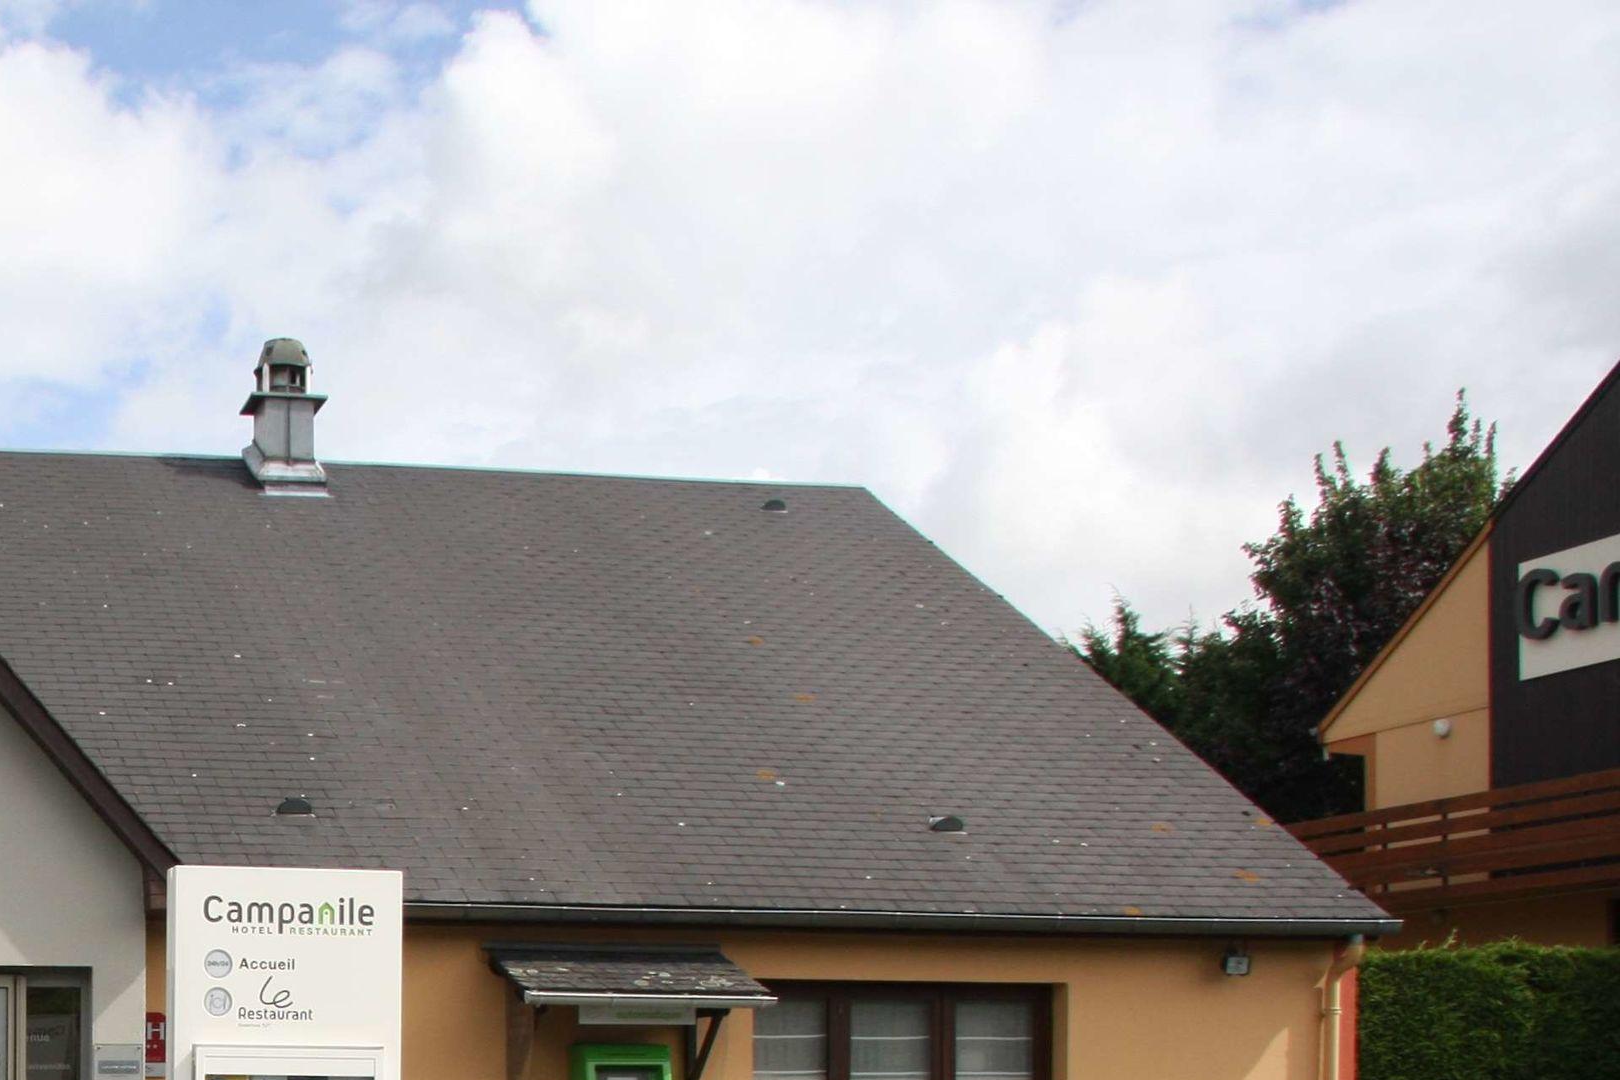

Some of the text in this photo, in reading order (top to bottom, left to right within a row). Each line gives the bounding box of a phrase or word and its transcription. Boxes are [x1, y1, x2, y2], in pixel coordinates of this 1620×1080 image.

[203, 895, 375, 934] Campanile
[231, 925, 373, 936] HOTEL RESTAURANT
[239, 957, 295, 971] Accueil
[238, 1007, 313, 1021] Restaurant
[146, 1022, 165, 1040] H
